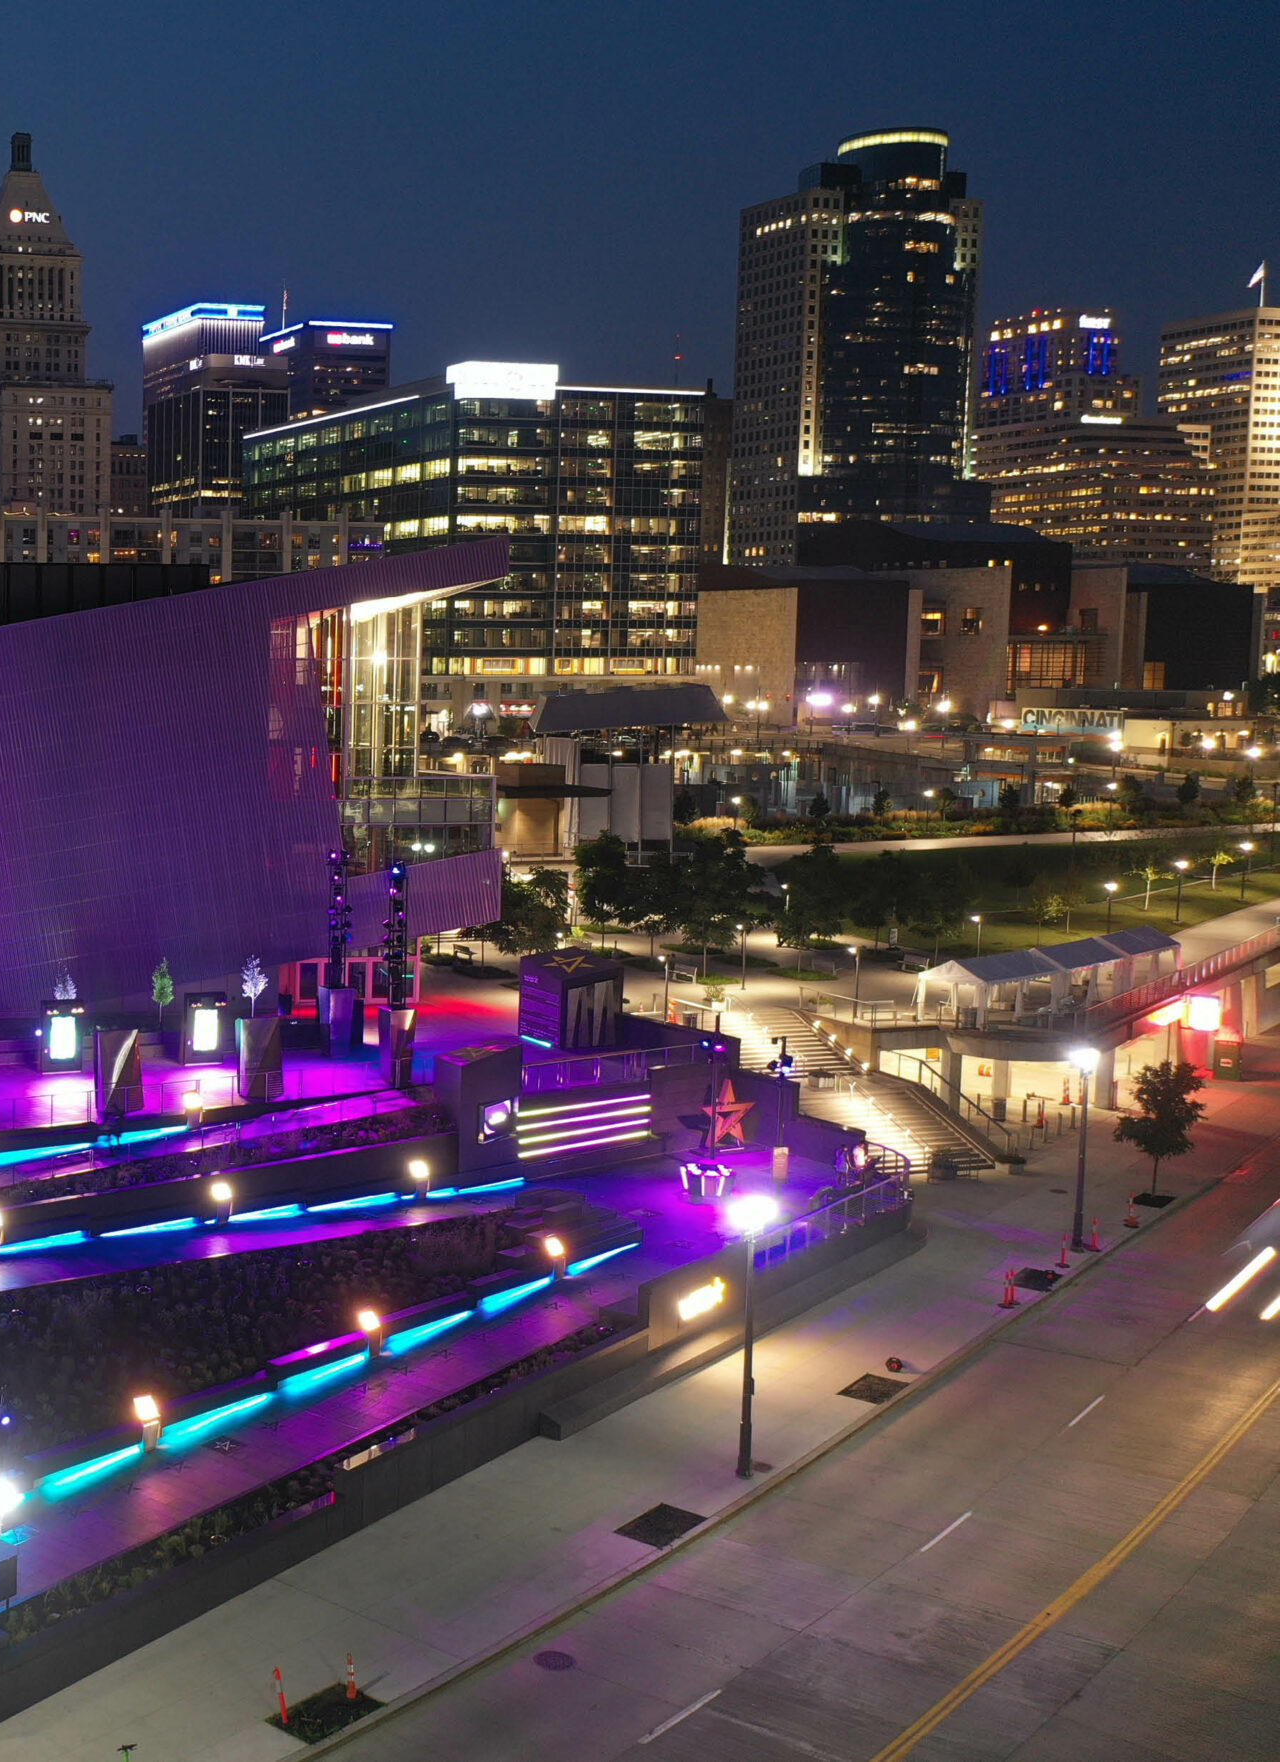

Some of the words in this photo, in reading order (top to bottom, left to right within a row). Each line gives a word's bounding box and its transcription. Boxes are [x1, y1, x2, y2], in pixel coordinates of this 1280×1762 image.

[24, 211, 50, 223] PNC
[234, 354, 251, 365] KMK
[1023, 709, 1123, 728] CINCINNATI
